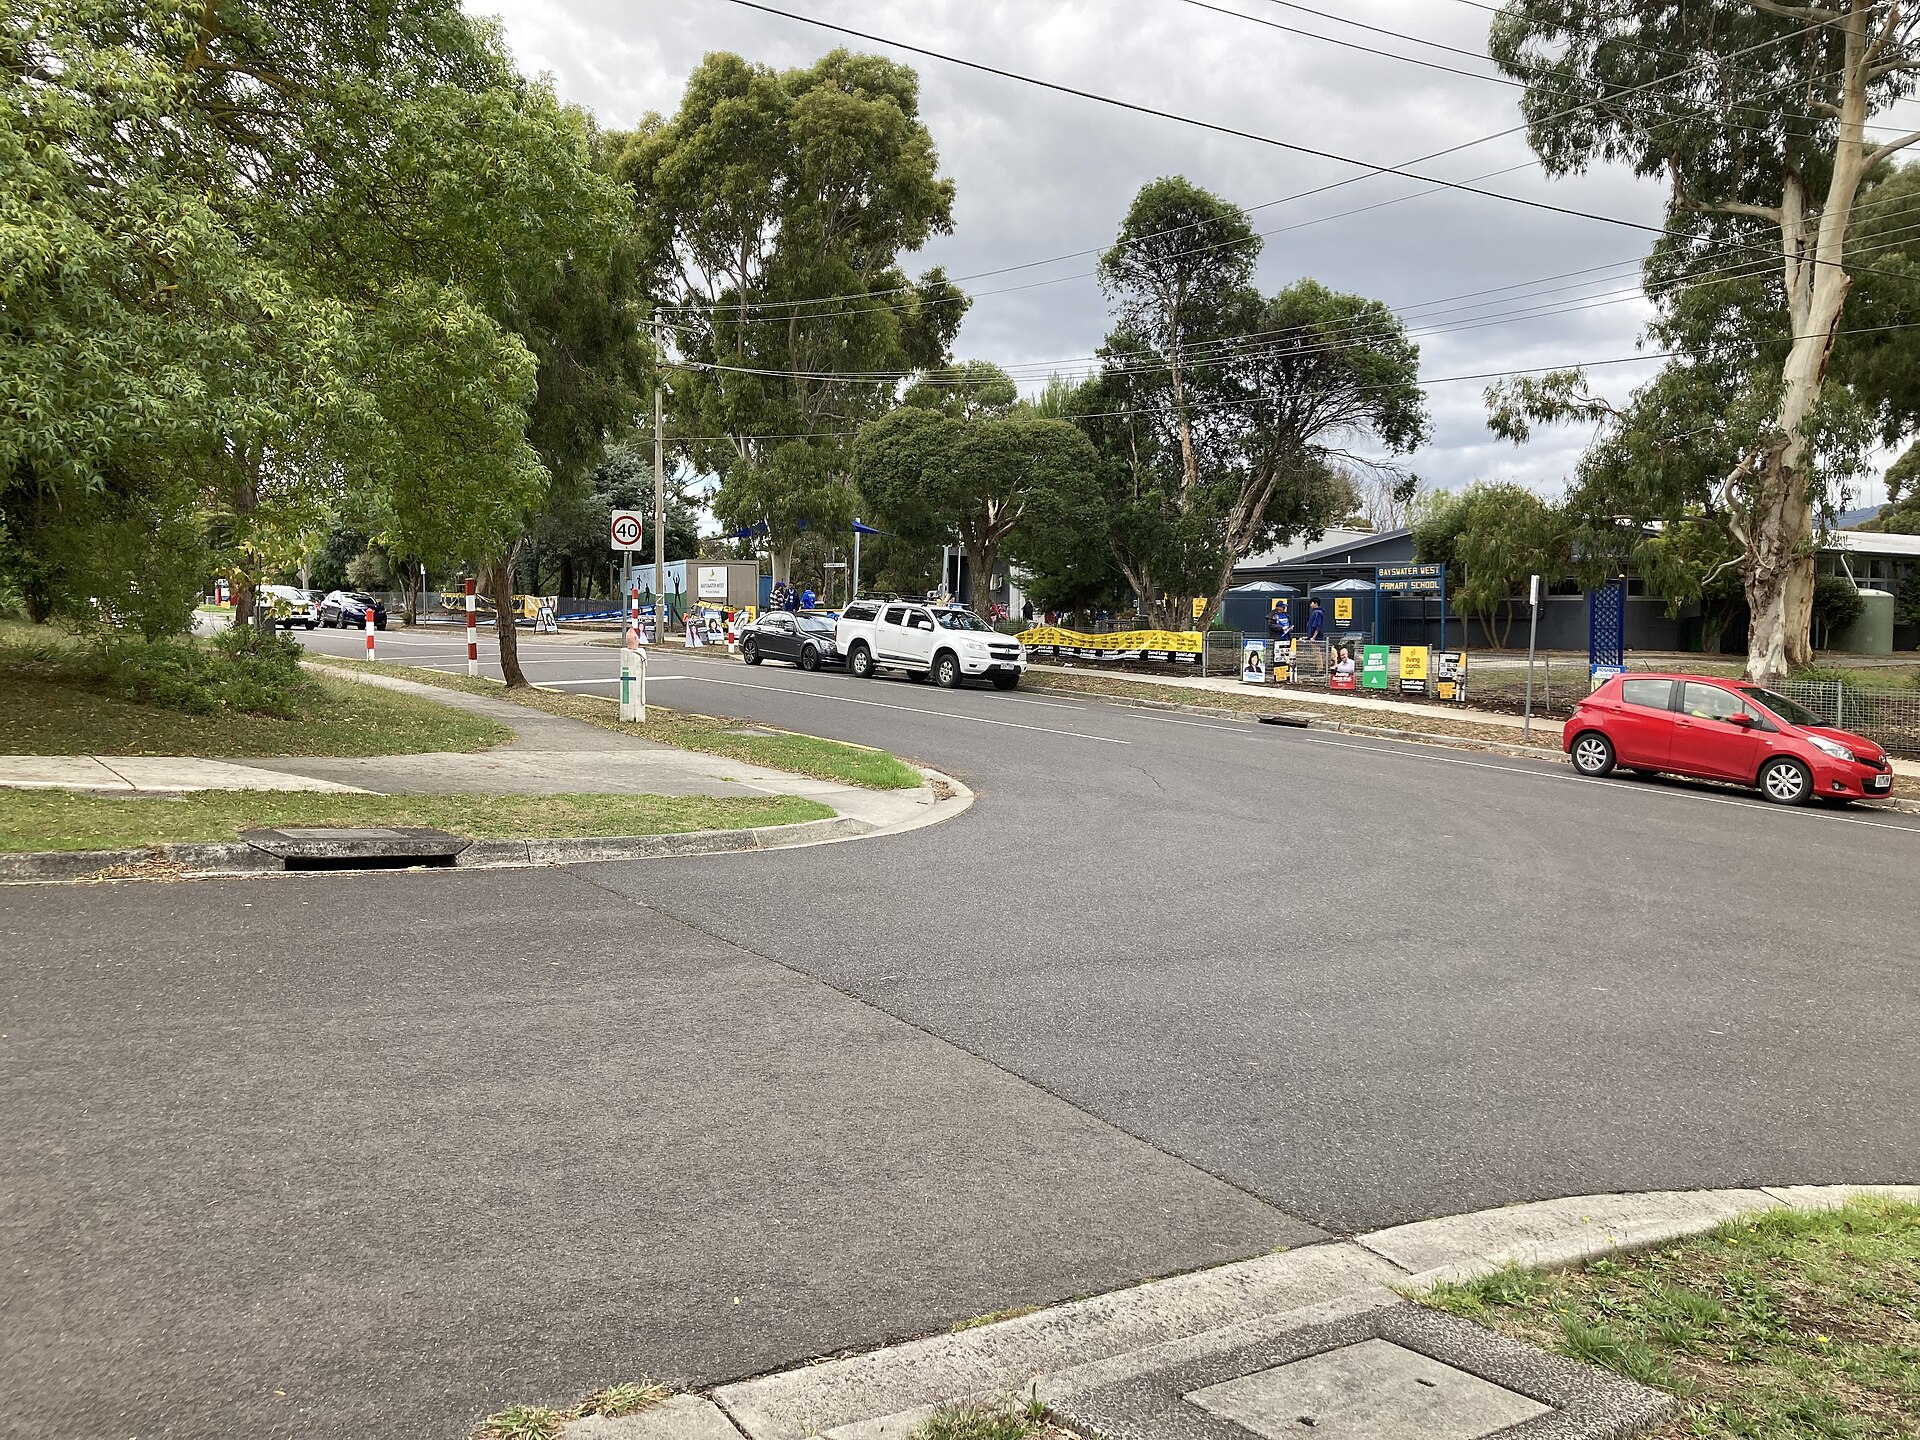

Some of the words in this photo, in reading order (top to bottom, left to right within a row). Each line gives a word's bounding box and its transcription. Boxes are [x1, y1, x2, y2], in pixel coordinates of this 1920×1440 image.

[616, 523, 638, 537] 40
[1378, 567, 1418, 576] BAYSWATER
[1420, 566, 1440, 574] WEST
[1380, 582, 1408, 590] PRIMARY
[1410, 581, 1440, 589] SCHOOL
